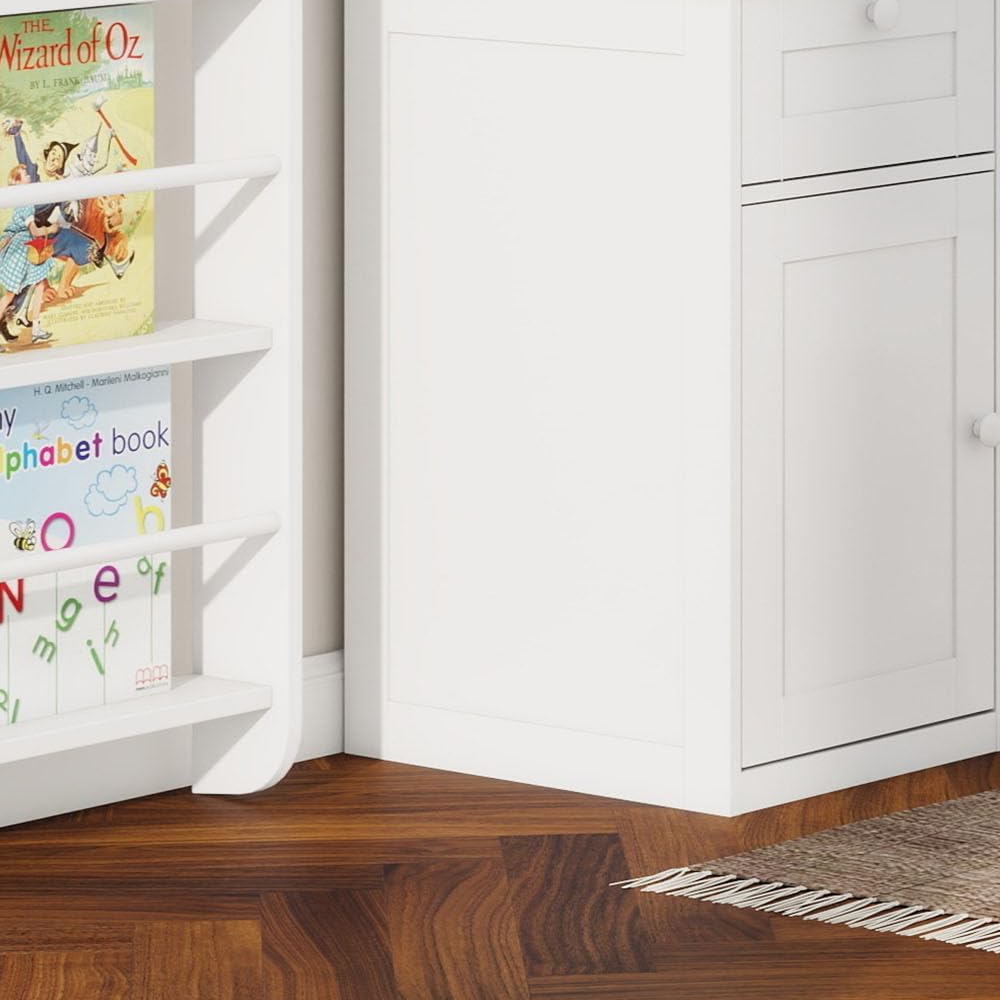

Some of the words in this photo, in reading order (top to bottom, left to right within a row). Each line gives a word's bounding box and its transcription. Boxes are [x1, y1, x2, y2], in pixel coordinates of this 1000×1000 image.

[22, 19, 54, 33] THE
[0, 27, 72, 71] Wizard
[77, 21, 103, 64] of
[105, 22, 144, 60] Oz
[30, 81, 38, 90] BY
[55, 380, 85, 393] Mitchell
[0, 408, 16, 437] y
[112, 420, 169, 455] book
[94, 565, 120, 603] e
[55, 597, 83, 632] g
[104, 620, 120, 647] h
[32, 634, 57, 664] m
